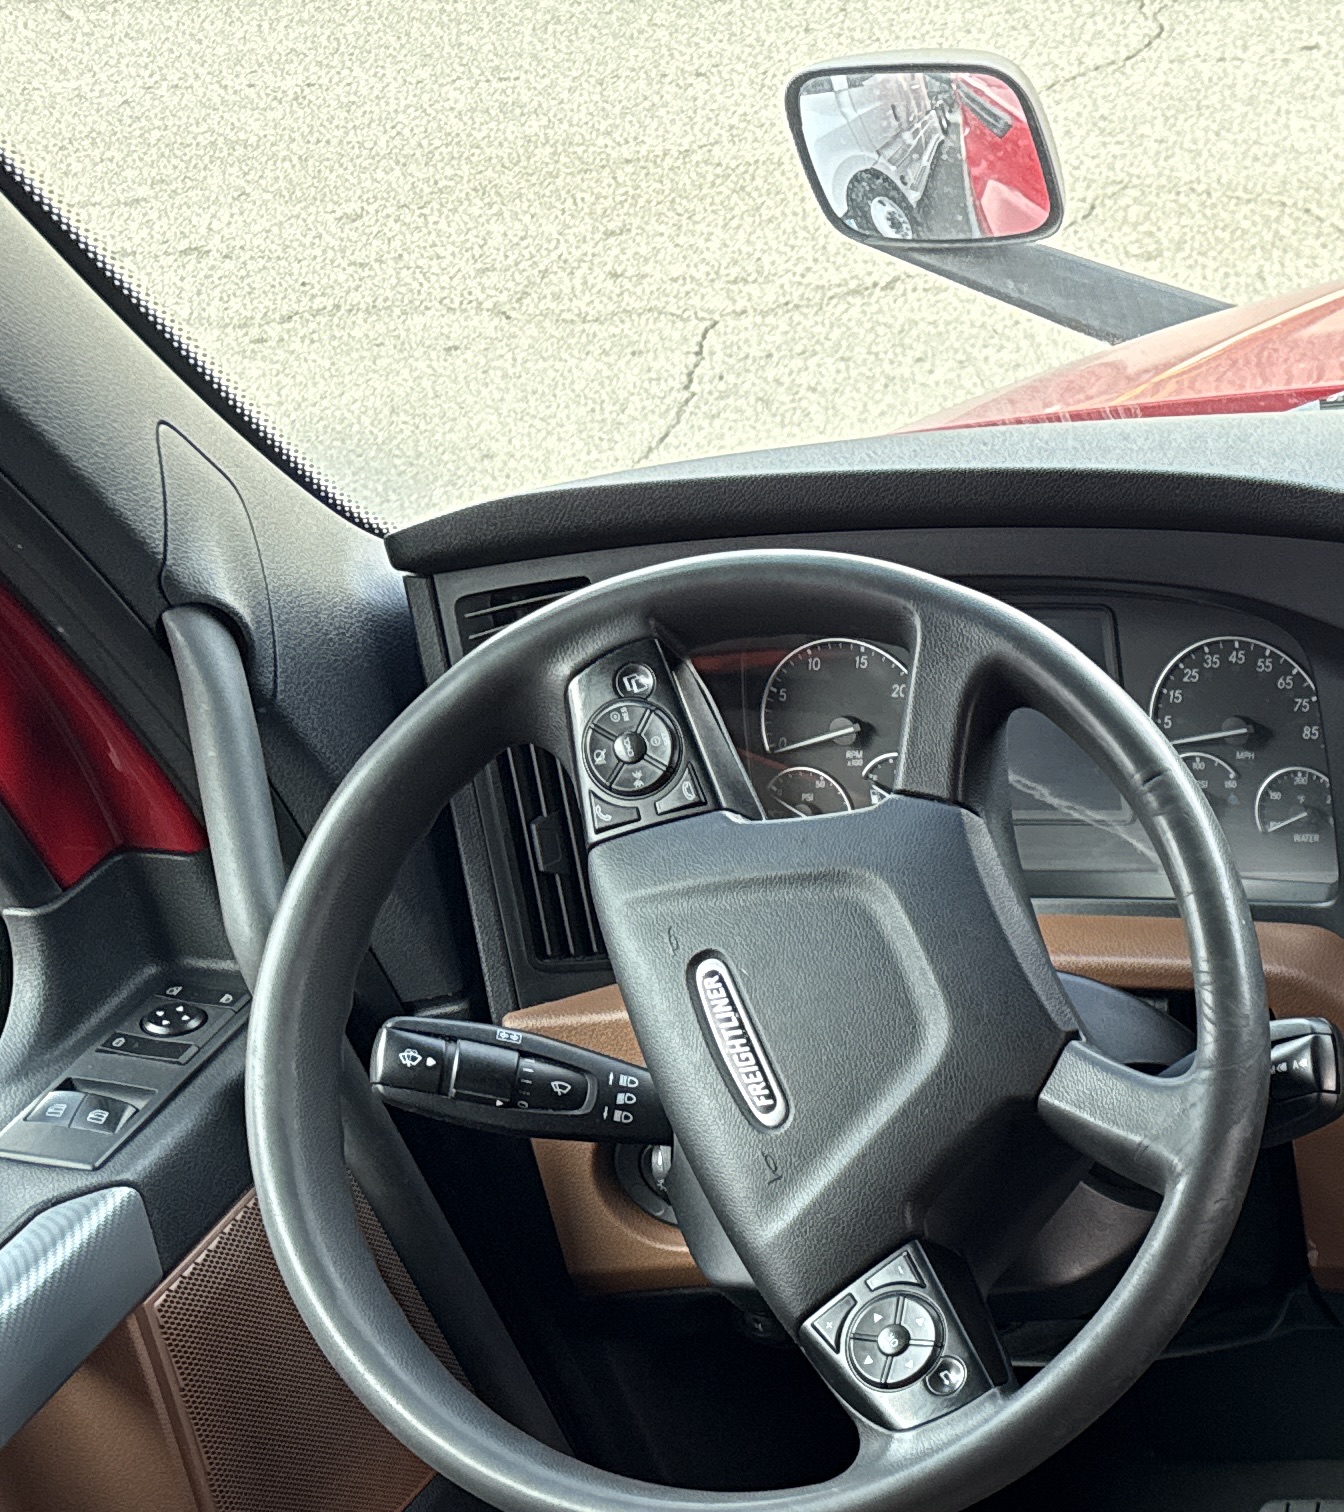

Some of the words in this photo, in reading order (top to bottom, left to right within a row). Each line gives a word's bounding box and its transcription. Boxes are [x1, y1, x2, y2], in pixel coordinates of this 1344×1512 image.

[808, 658, 821, 670] 10
[855, 656, 868, 668] 15
[1203, 655, 1220, 668] 35
[1228, 651, 1245, 664] 45
[1256, 659, 1272, 672] 55
[1183, 669, 1199, 682] 25
[1278, 676, 1293, 689] 65
[779, 689, 787, 701] 5
[1169, 690, 1182, 703] 15
[1293, 699, 1310, 712] 75
[1163, 715, 1172, 728] 5
[1302, 726, 1319, 739] 85
[846, 750, 863, 758] RPM
[1236, 751, 1254, 760] MPH
[1294, 834, 1319, 842] WATER
[703, 974, 775, 1107] FREIGHTLINER
